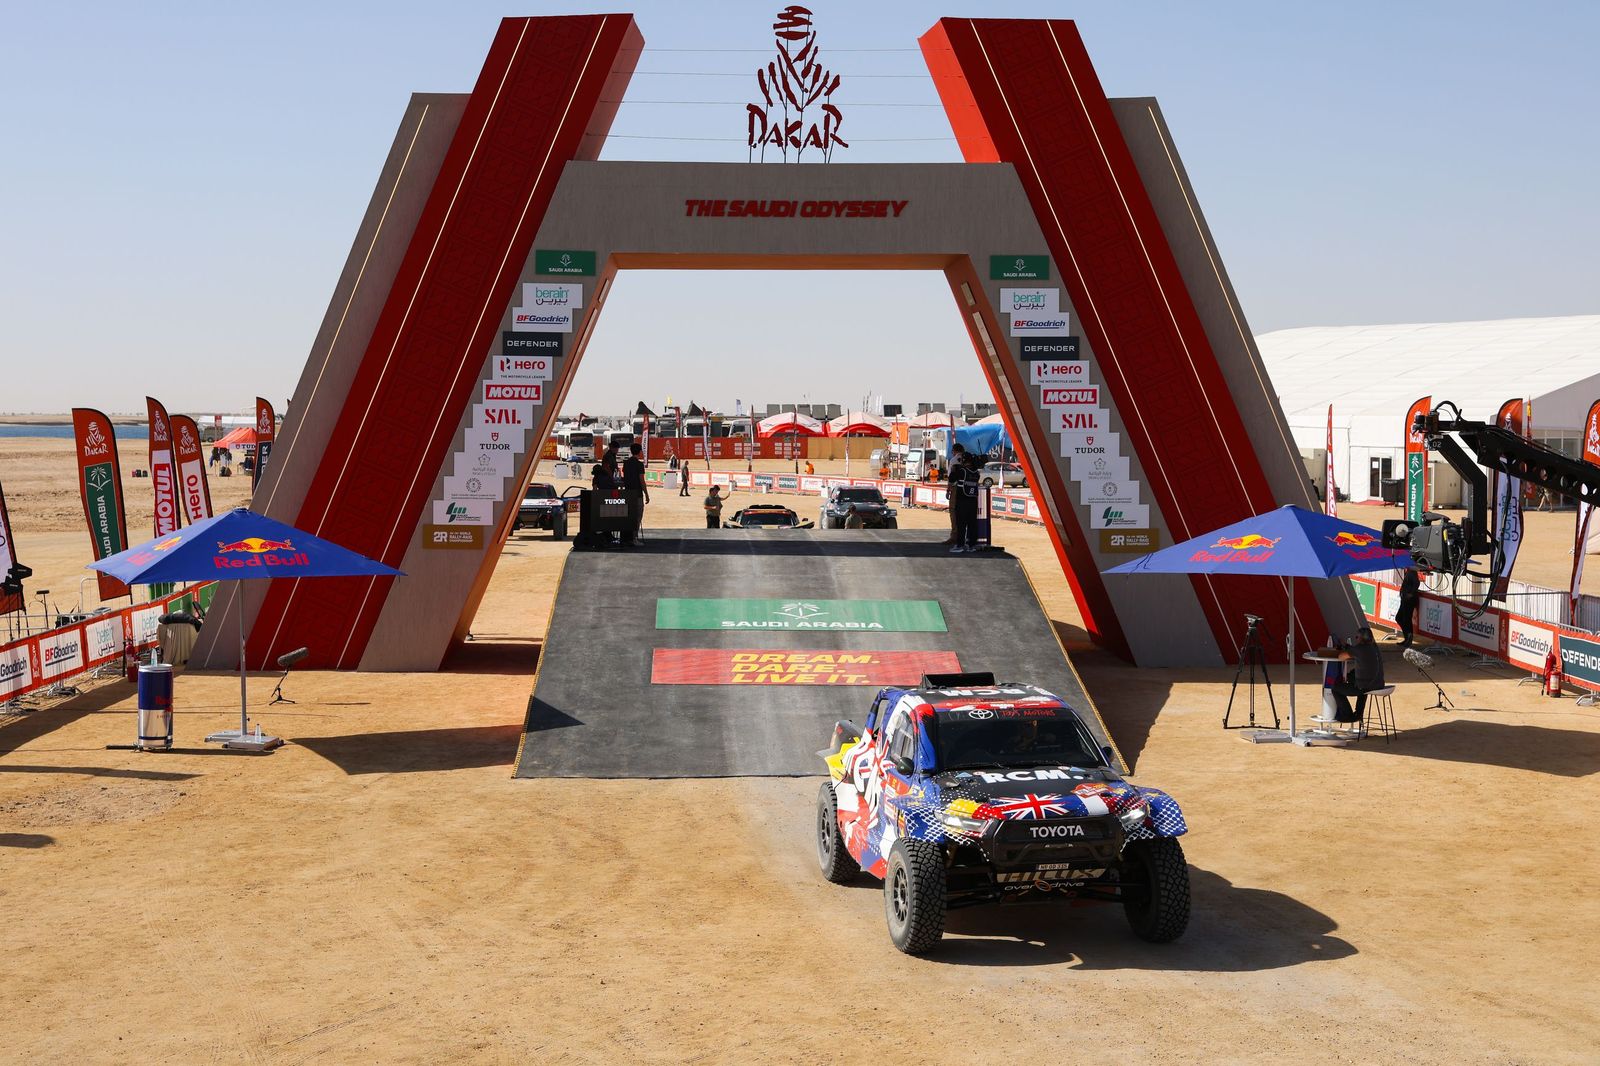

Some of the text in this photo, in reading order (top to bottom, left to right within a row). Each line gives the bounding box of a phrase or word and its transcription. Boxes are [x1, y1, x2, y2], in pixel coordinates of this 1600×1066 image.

[746, 103, 848, 148] DAKAR
[686, 199, 909, 217] THE SAUDI ODYSSEY
[535, 286, 569, 298] berain
[1013, 291, 1045, 303] berain
[516, 314, 569, 323] BFGoodrich
[507, 340, 558, 348] DEFENDER
[488, 387, 539, 398] MOTUL
[1045, 391, 1095, 402] MOTUL
[84, 443, 109, 457] DAKAR
[96, 495, 109, 534] ARABIA
[213, 553, 310, 569] Red Bull
[1189, 550, 1275, 562] Red Bull
[797, 621, 884, 629] ARABIA
[1511, 629, 1548, 653] BFGoodrich
[45, 641, 79, 662] BFGoodrich
[730, 653, 881, 664] DREAM.
[1561, 648, 1600, 673] DEFENDE
[730, 664, 847, 673] DARE.
[730, 673, 871, 683] LIVE IT.
[978, 769, 1084, 784] RCM.
[1030, 825, 1085, 838] TOYOTA
